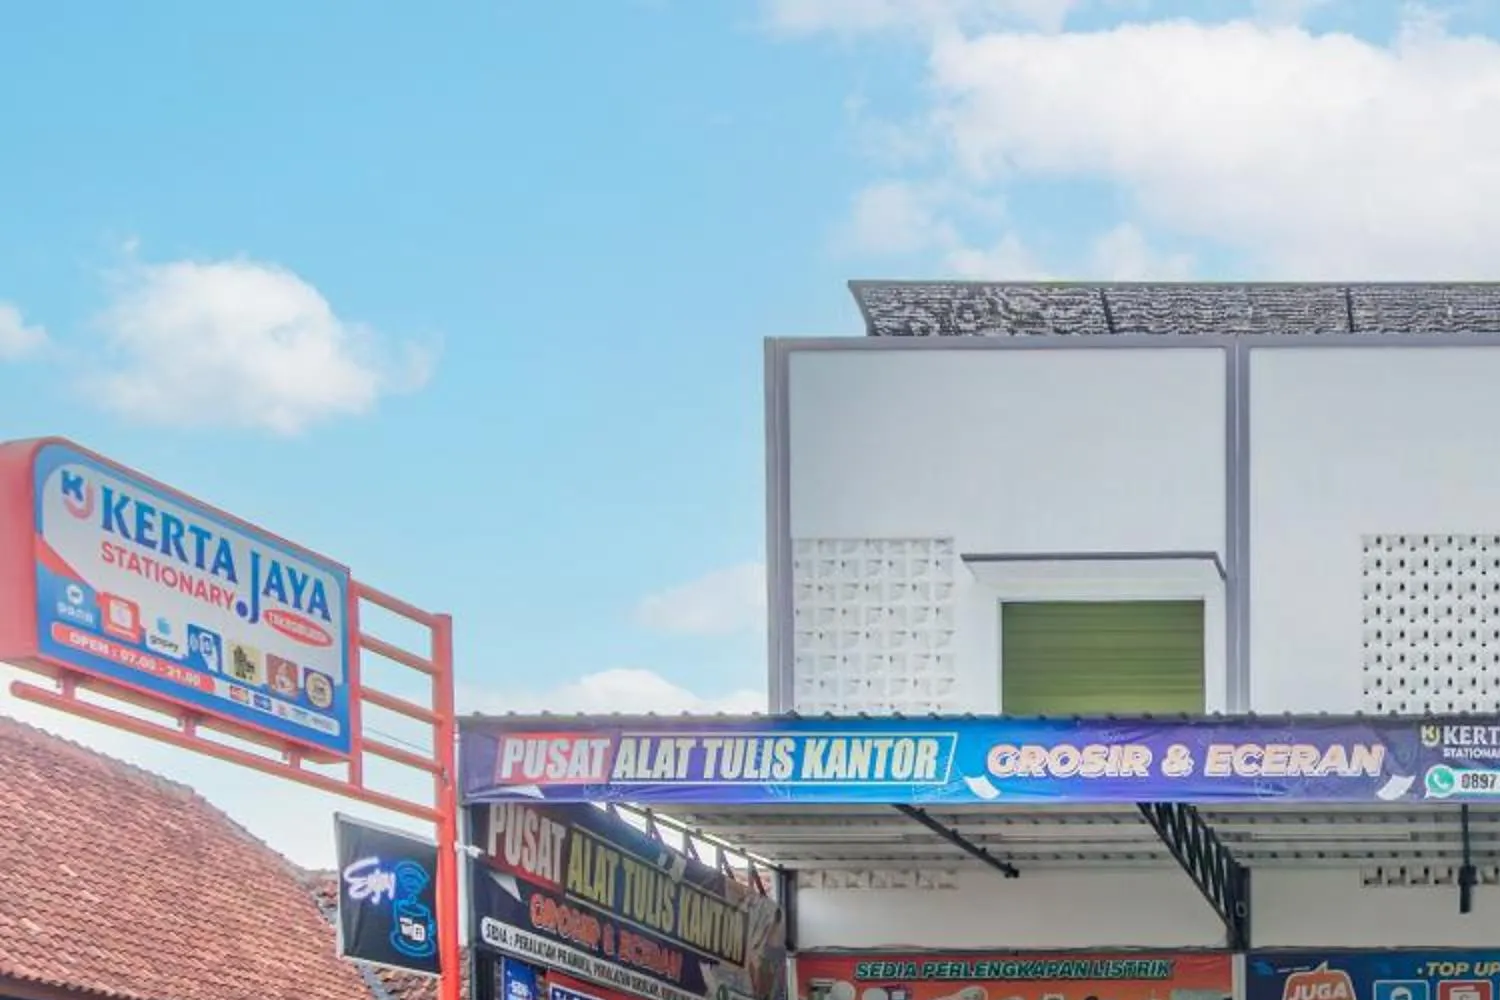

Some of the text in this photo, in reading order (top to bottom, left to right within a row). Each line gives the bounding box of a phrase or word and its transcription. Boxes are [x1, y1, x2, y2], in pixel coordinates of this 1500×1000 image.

[101, 484, 332, 624] KERTA JAYA
[101, 541, 236, 611] STATIONARY
[69, 631, 109, 655] OPEN
[500, 737, 939, 780] PUSAT ALAT TULIS KANTOR
[987, 743, 1387, 778] GROSIR & ECERAN
[1461, 773, 1496, 789] 0897
[487, 800, 566, 884] PUSAT
[566, 829, 619, 908] ALAT
[621, 856, 675, 934] TULIS
[856, 960, 1174, 979] SEDIA PERLENGKAPAN LISTRIK
[1425, 962, 1471, 977] TOP
